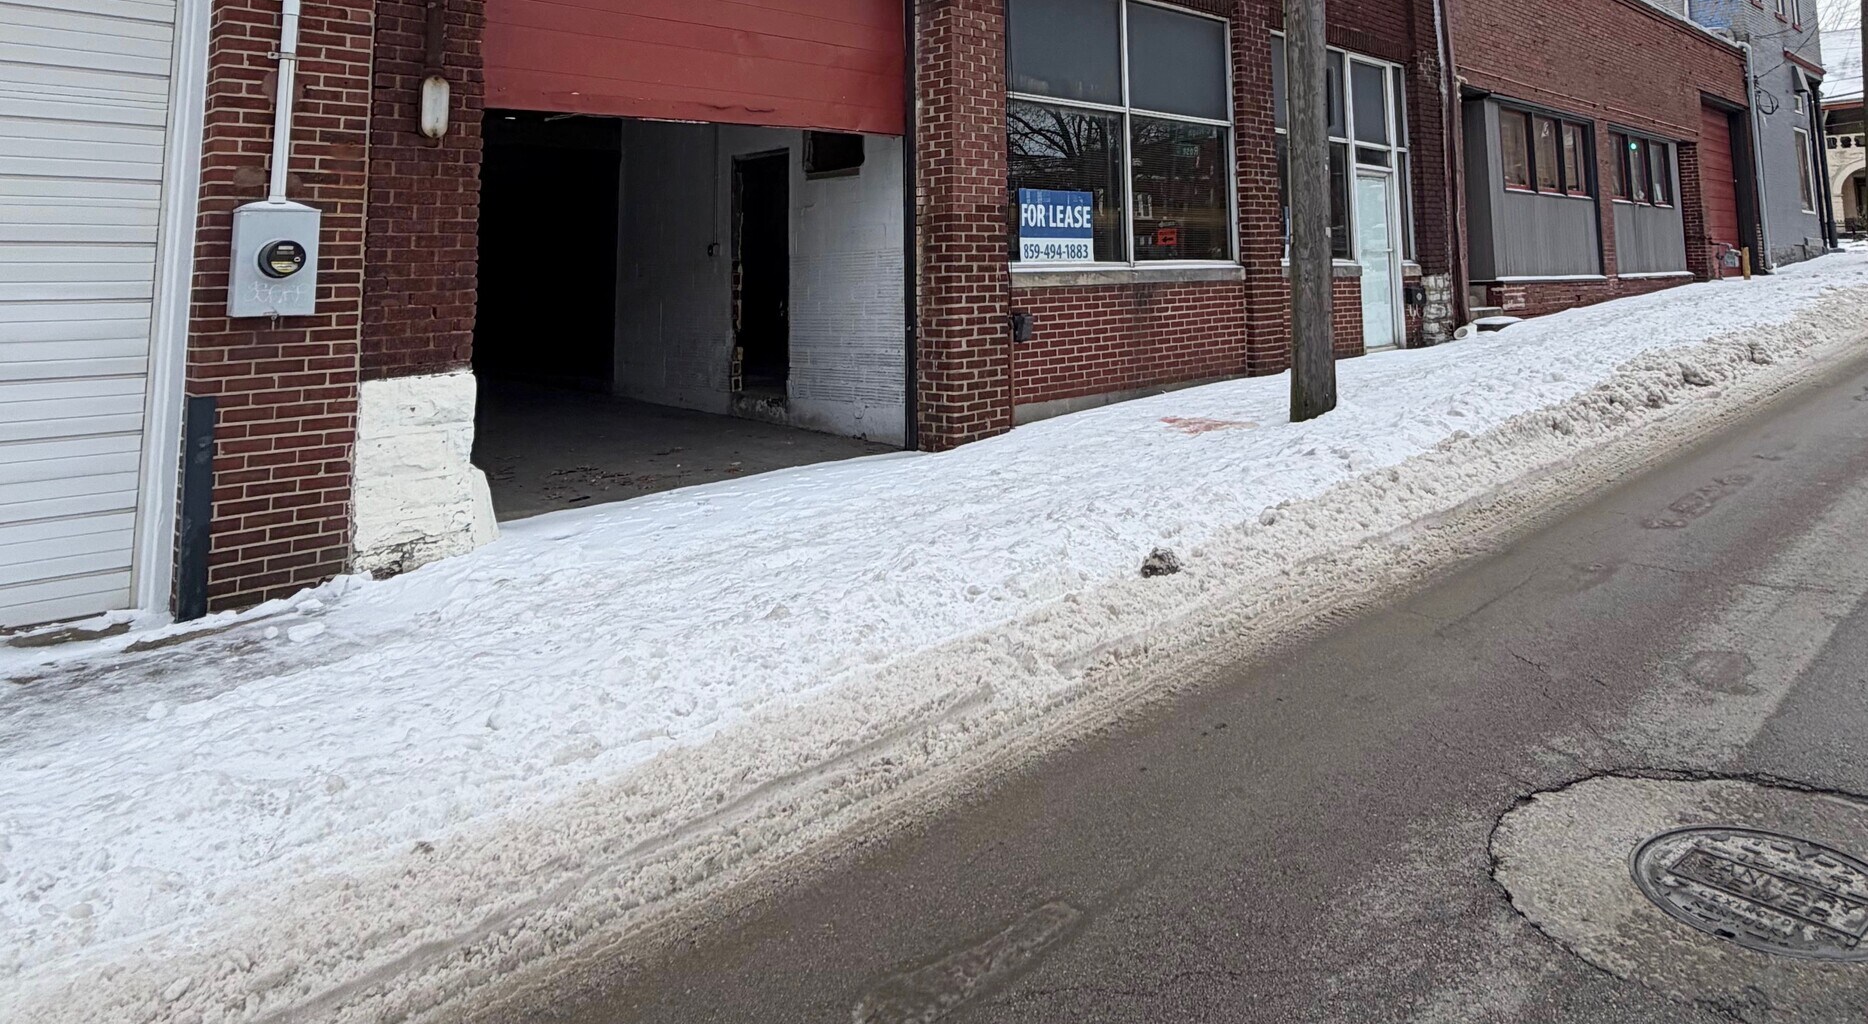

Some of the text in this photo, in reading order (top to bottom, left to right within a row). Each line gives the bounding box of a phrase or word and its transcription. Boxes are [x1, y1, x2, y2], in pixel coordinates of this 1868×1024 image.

[1021, 203, 1092, 229] FOR LEASE
[1023, 243, 1089, 260] 859-494-1883
[1697, 855, 1863, 914] SANITARY
[1703, 870, 1834, 923] SEWER
[1690, 897, 1796, 941] KENTUCKY
[1697, 888, 1807, 933] LEXINGTON
